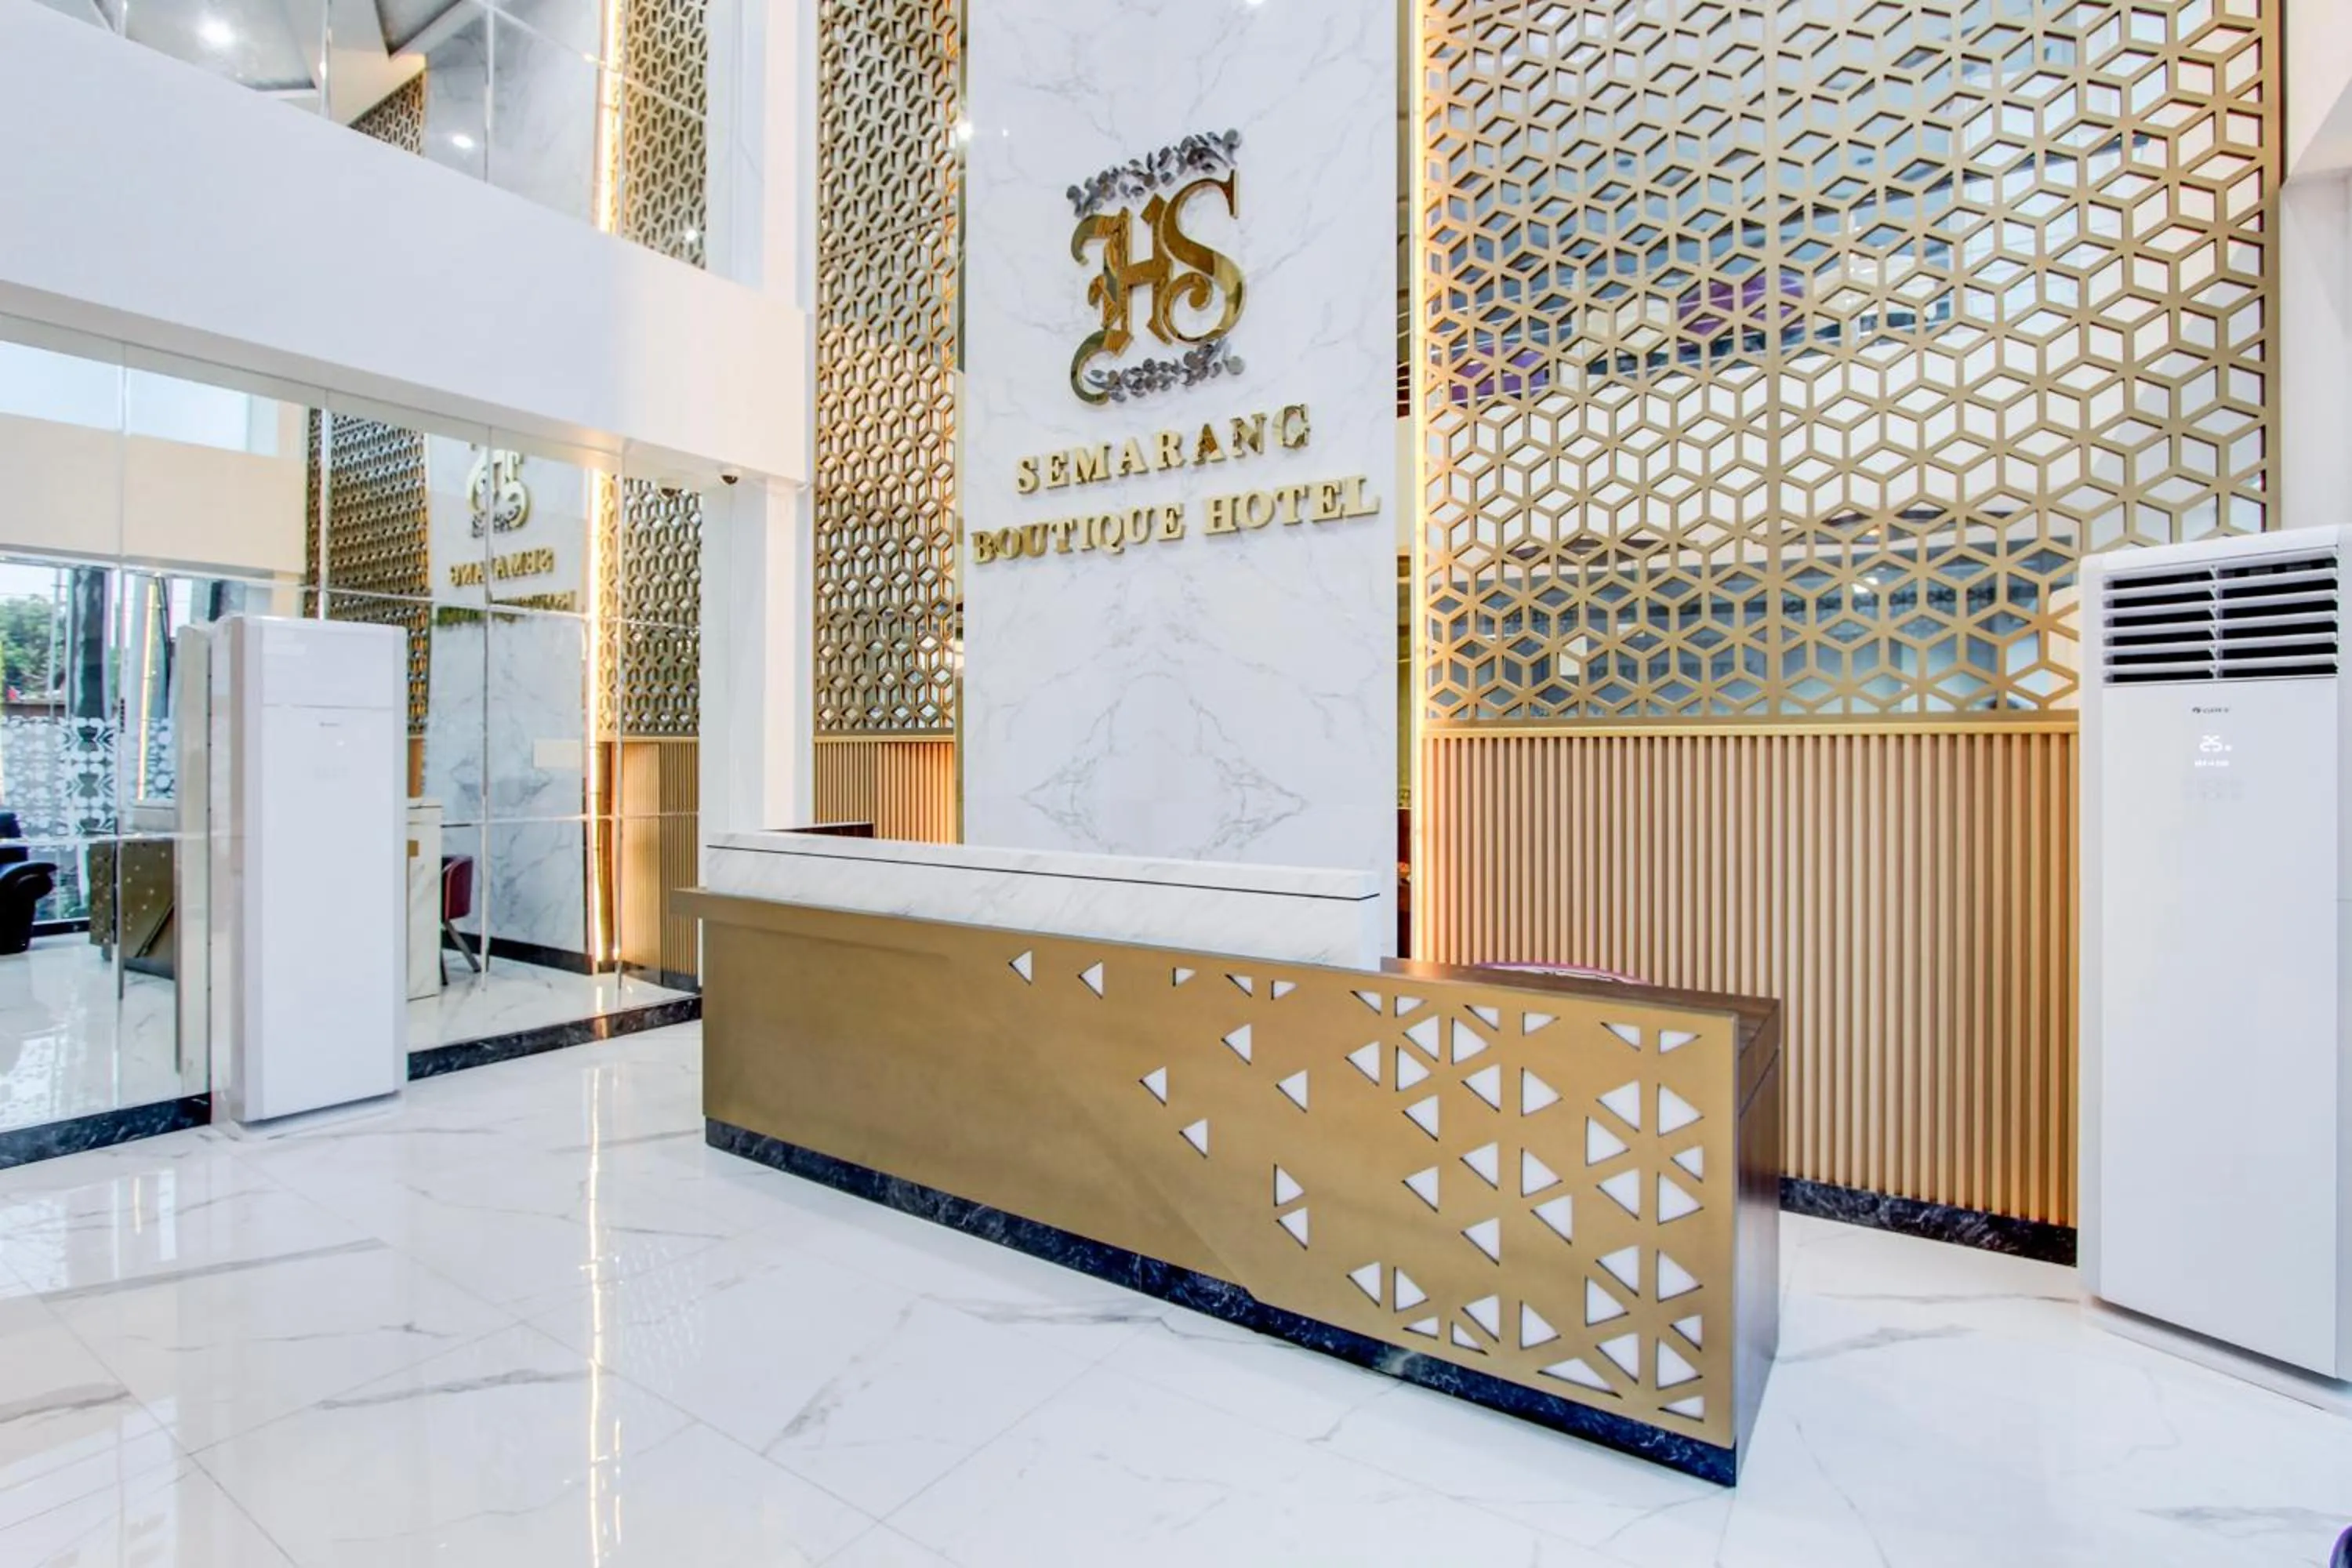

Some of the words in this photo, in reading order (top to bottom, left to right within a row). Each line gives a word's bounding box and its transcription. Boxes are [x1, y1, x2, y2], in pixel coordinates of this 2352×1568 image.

[1015, 403, 1311, 495] SEMARANG
[971, 502, 1186, 565] BOUTIQUE
[1203, 475, 1380, 535] HOTEL
